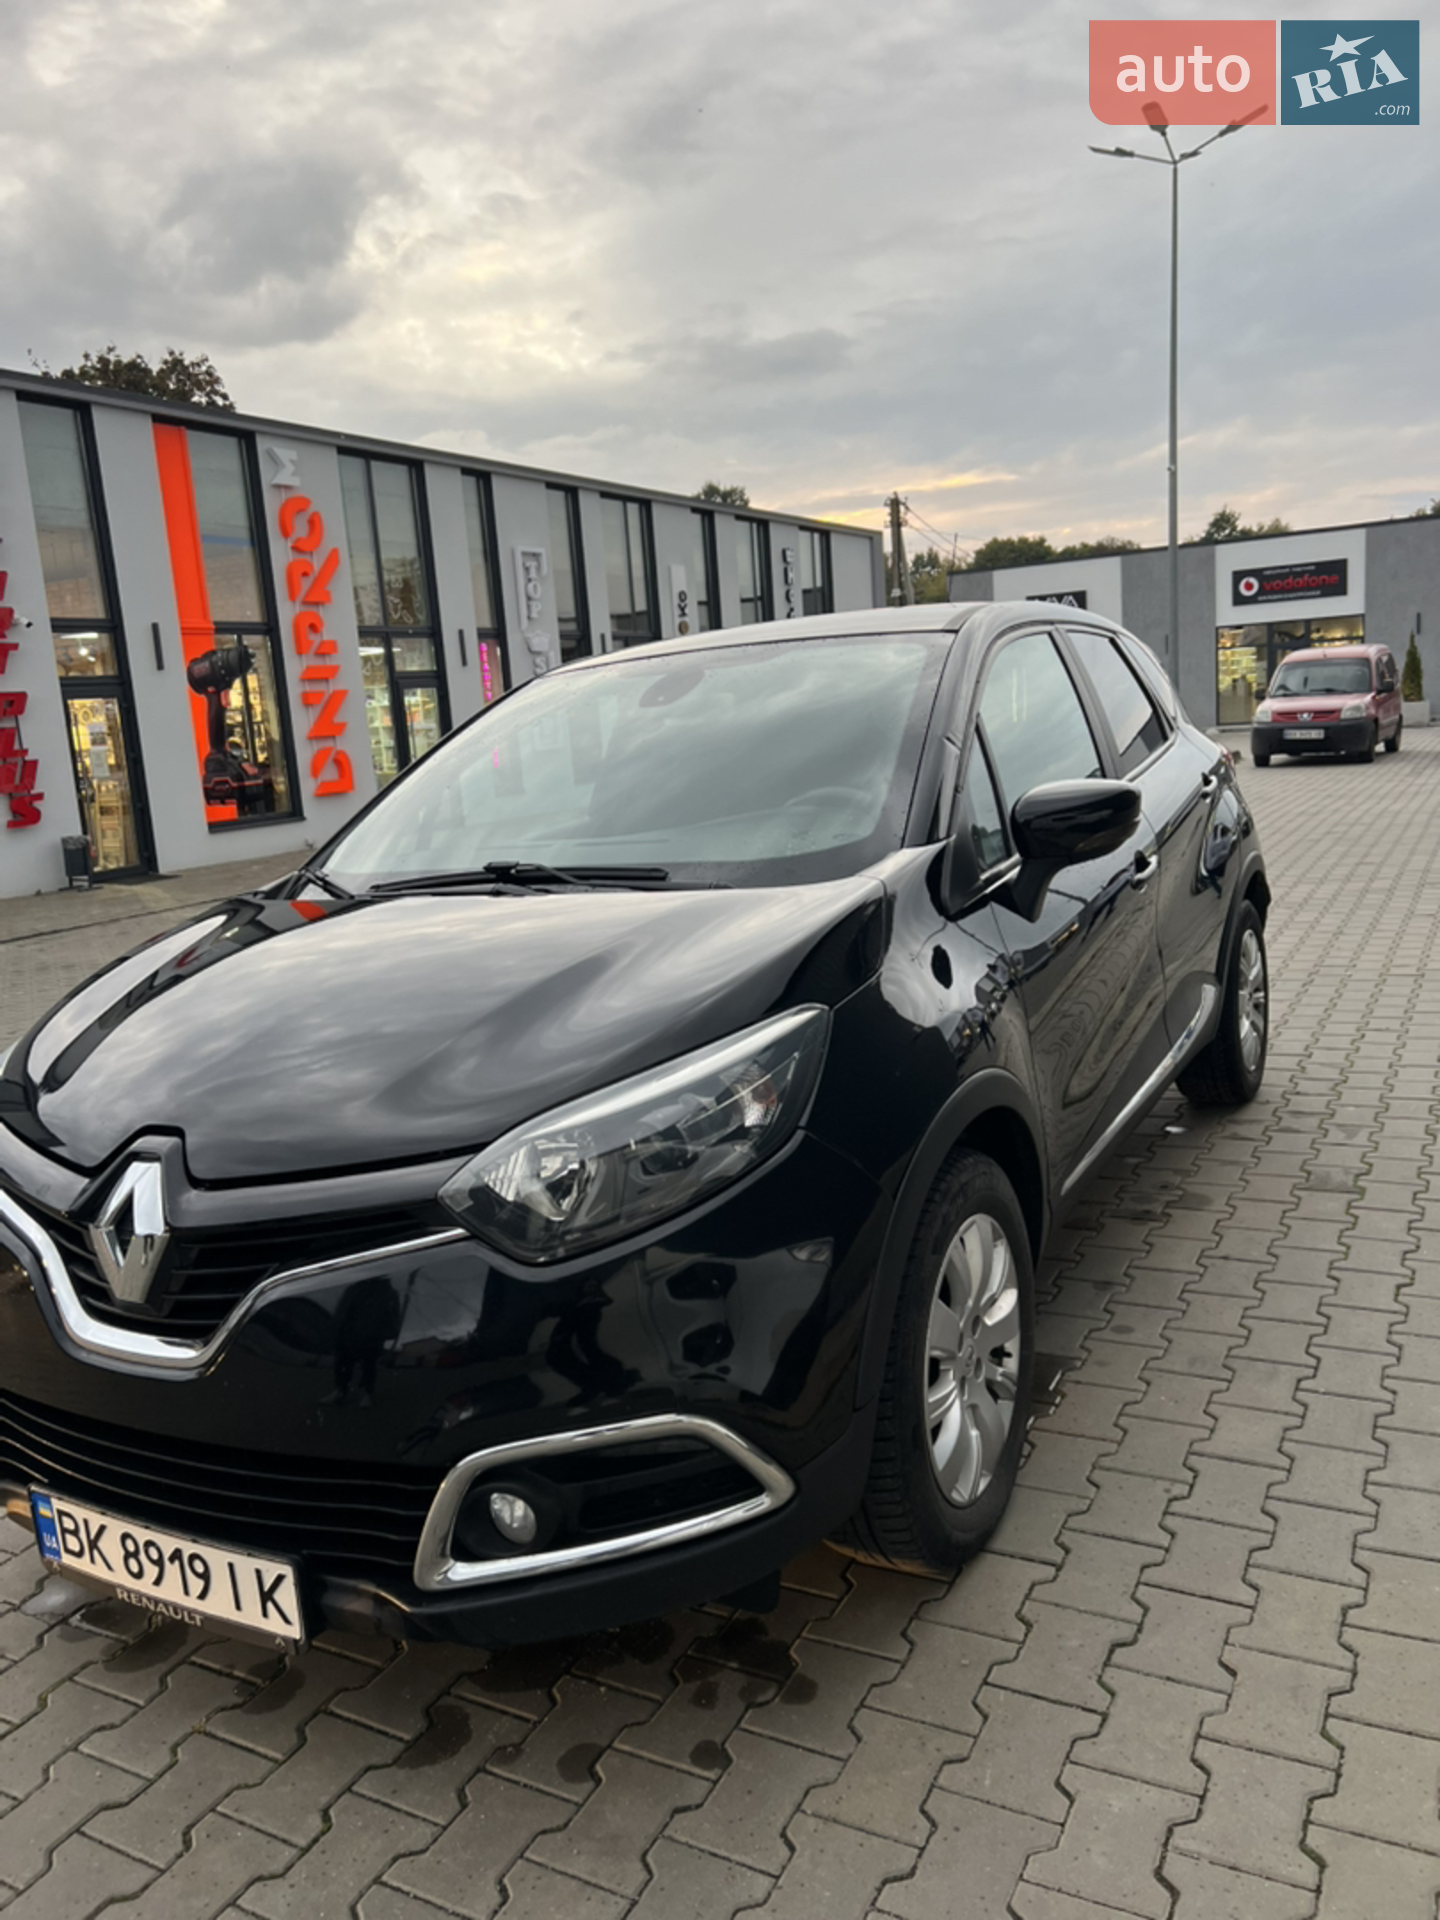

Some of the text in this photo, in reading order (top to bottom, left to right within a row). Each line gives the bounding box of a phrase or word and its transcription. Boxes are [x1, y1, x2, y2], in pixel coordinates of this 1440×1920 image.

[524, 560, 542, 619] TOP
[1262, 573, 1338, 591] vodafone
[55, 1508, 114, 1573] BK
[120, 1532, 212, 1601] 8919
[115, 1587, 205, 1628] RENAULT
